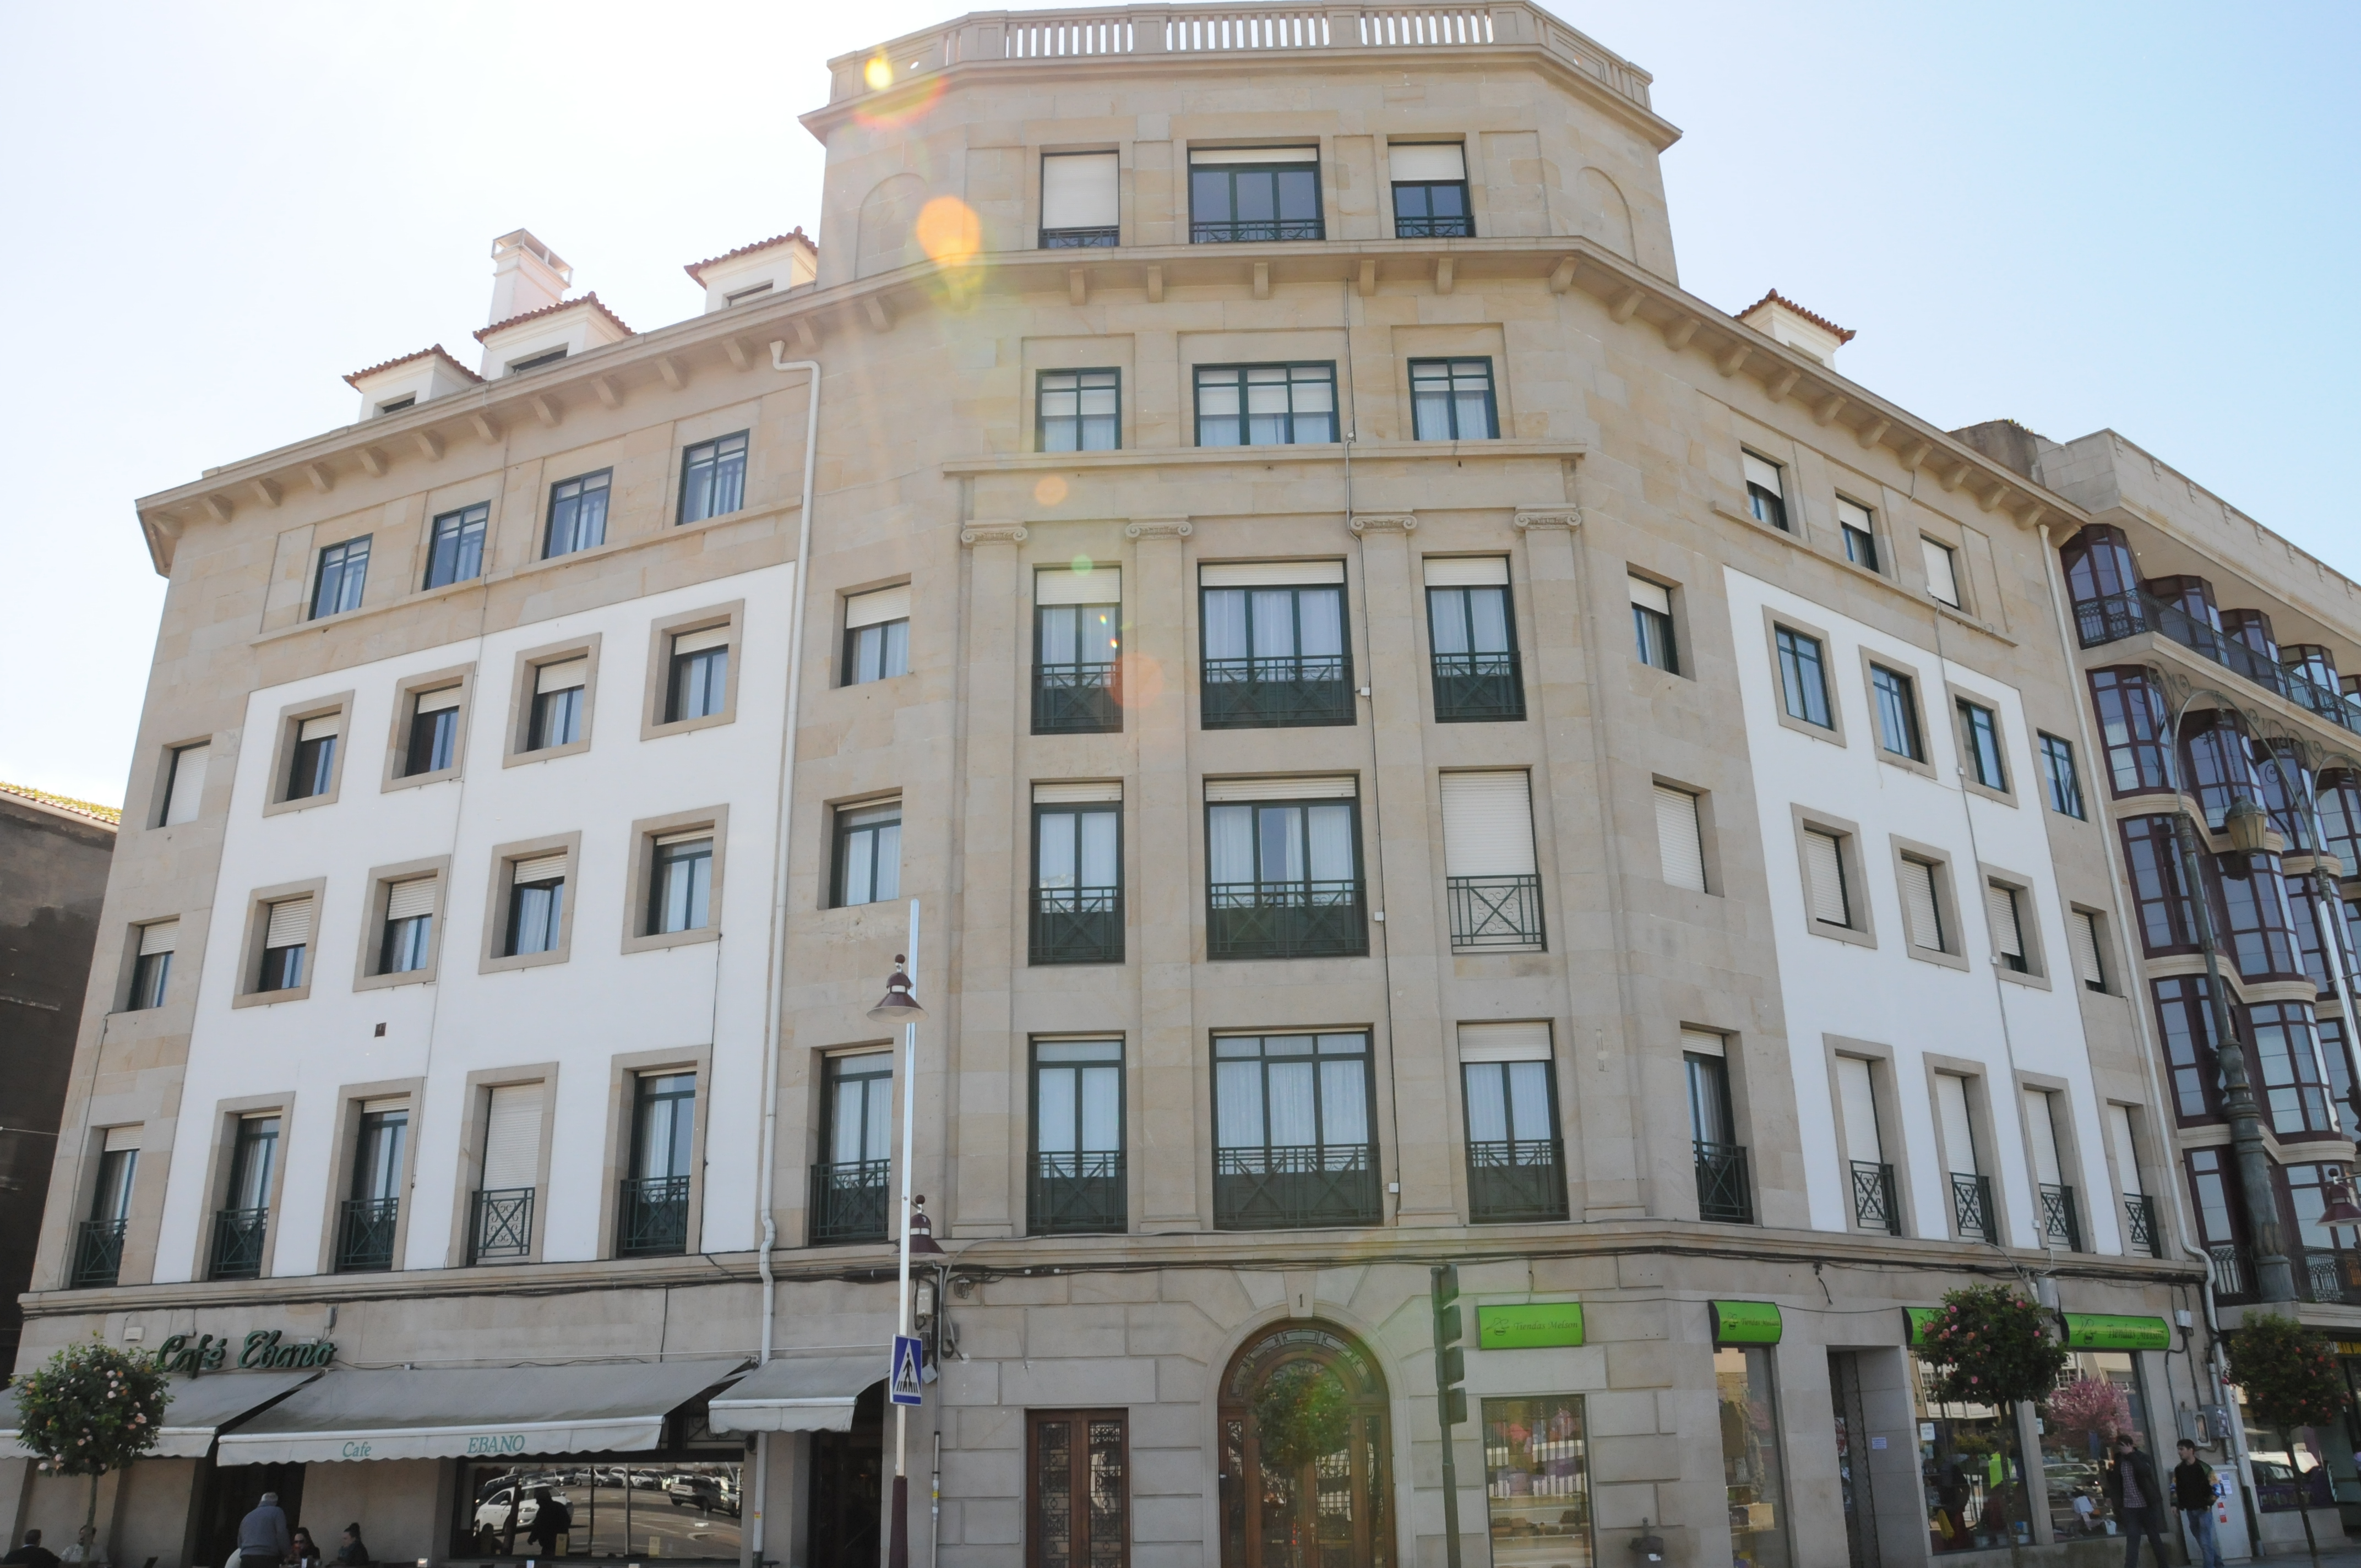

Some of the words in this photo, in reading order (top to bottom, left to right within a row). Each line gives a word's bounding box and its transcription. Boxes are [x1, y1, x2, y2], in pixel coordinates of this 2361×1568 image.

[1299, 1294, 1303, 1307] 1
[1514, 1320, 1546, 1330] Tiendas
[1548, 1320, 1578, 1329] Melson
[2107, 1324, 2136, 1339] Tiendas
[2137, 1325, 2164, 1340] Melson
[156, 1333, 227, 1378] Café
[238, 1330, 338, 1368] Ebano
[342, 1441, 372, 1457] Cafe
[466, 1435, 526, 1453] EBANO
